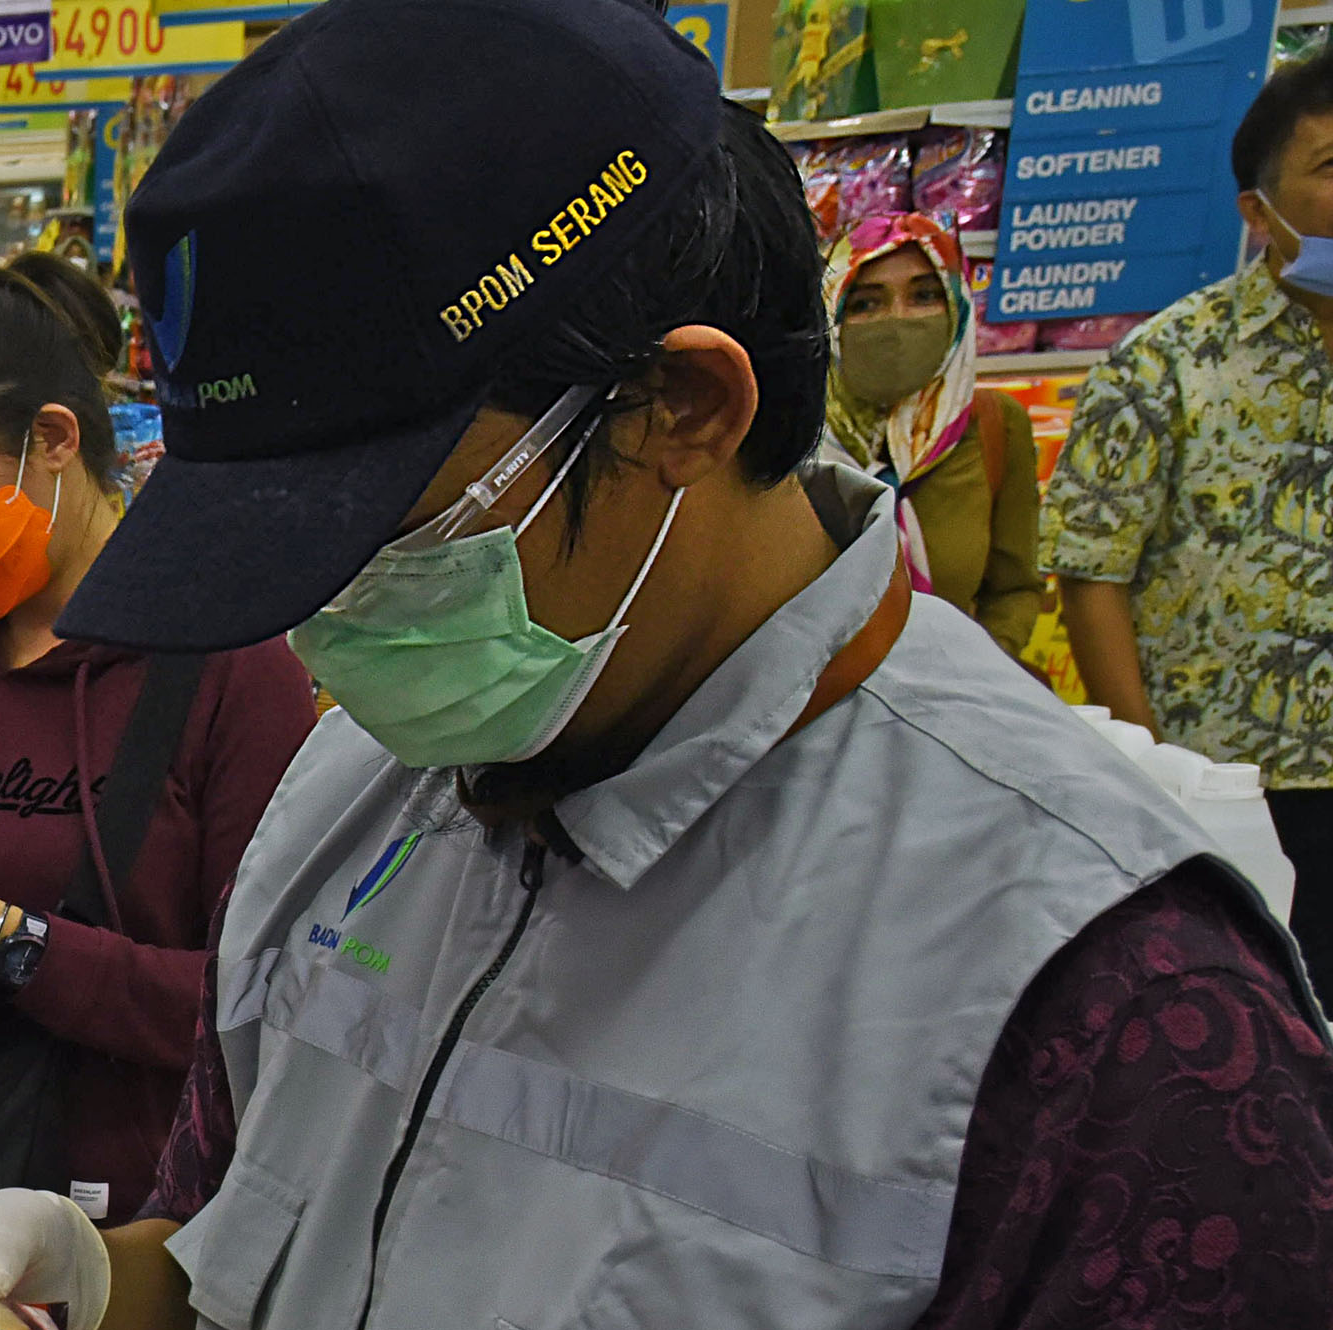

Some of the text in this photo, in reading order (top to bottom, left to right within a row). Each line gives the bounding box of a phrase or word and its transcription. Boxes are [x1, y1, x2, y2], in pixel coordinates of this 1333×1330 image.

[1026, 82, 1163, 116] CLEANING
[1017, 145, 1161, 181] SOFTENER
[1012, 198, 1138, 228] LAUNDRY
[440, 149, 649, 344] BPOM SERANG
[1010, 222, 1126, 253] POWDER
[1002, 260, 1127, 290] LAUNDRY
[999, 287, 1096, 315] CREAM
[197, 372, 259, 409] POM
[492, 449, 532, 489] PURITY
[340, 935, 393, 974] POM
